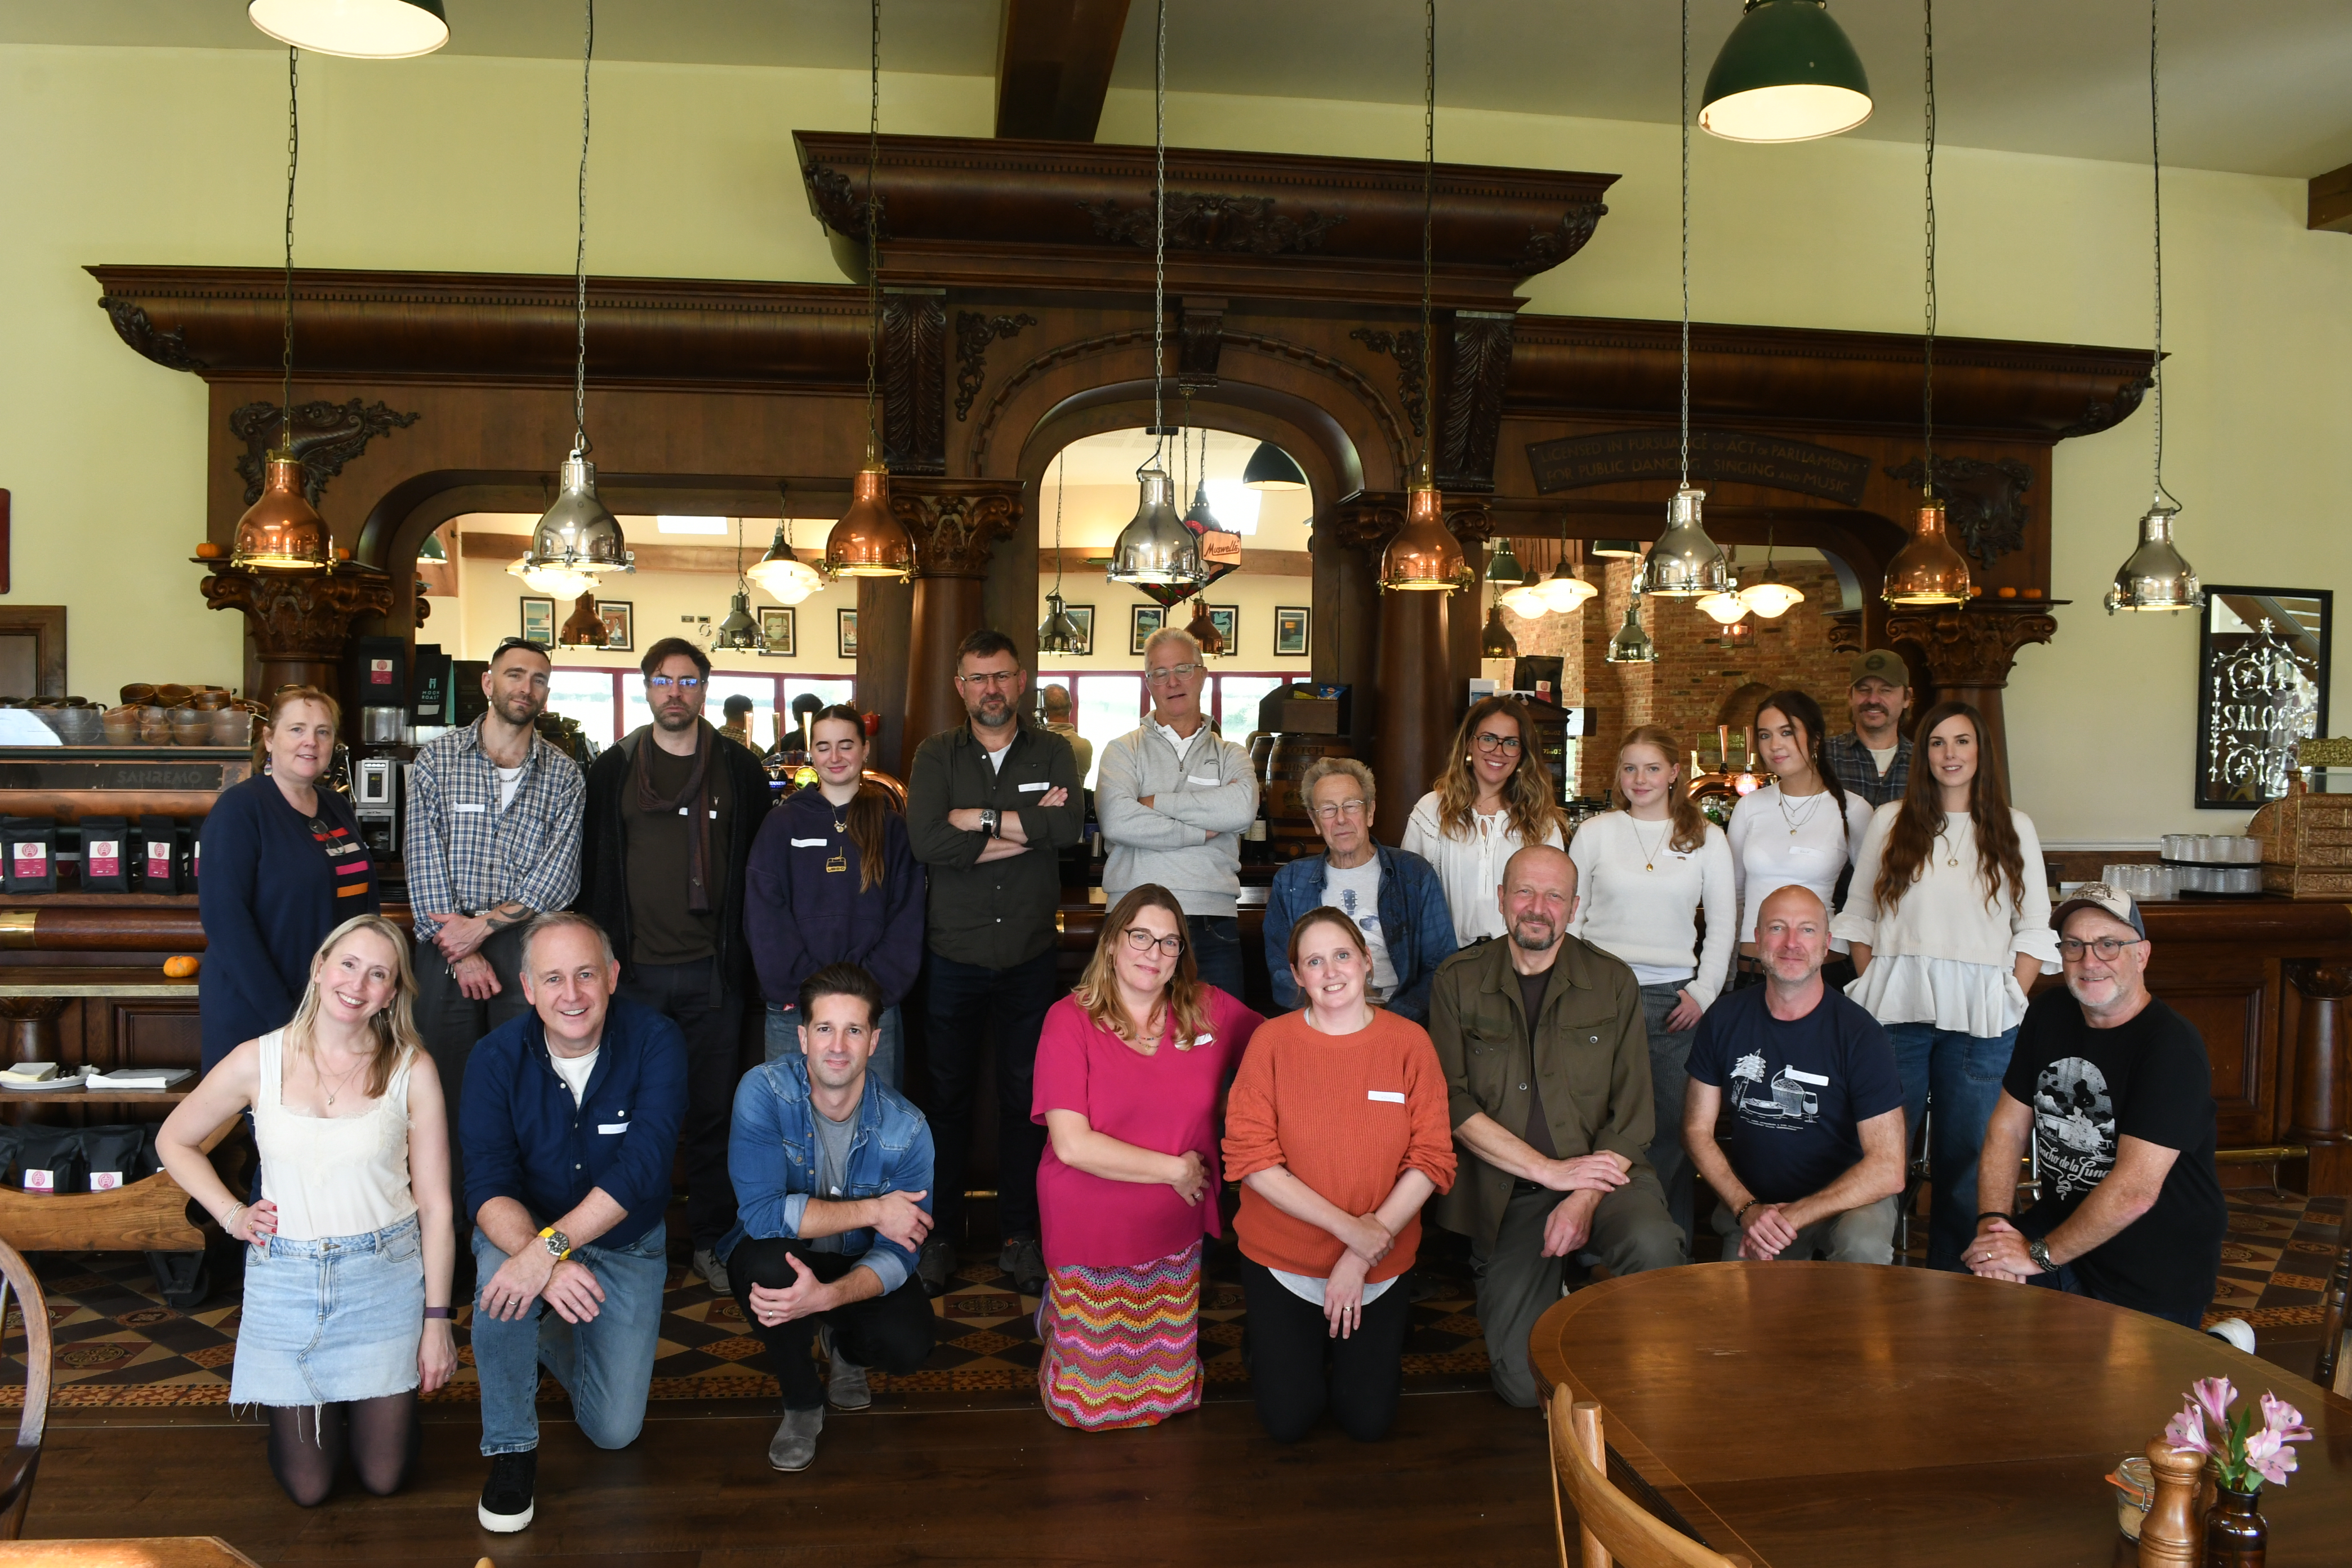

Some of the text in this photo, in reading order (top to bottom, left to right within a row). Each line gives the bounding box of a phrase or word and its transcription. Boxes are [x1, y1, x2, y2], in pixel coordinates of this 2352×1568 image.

[1542, 442, 1602, 462] LICENSED
[1607, 439, 1623, 453] IN
[1726, 440, 1757, 454] ACT
[1771, 444, 1860, 475] PARLIAMENT
[1547, 467, 1574, 483] FOR
[1578, 460, 1625, 478] PUBLIC
[1713, 458, 1775, 478] SINGING
[1779, 472, 1799, 483] AND
[1803, 472, 1850, 493] MUSIC
[1280, 746, 1325, 755] SCOTCH
[117, 770, 203, 784] SANREMO
[2059, 1156, 2069, 1170] de
[2069, 1159, 2079, 1173] la
